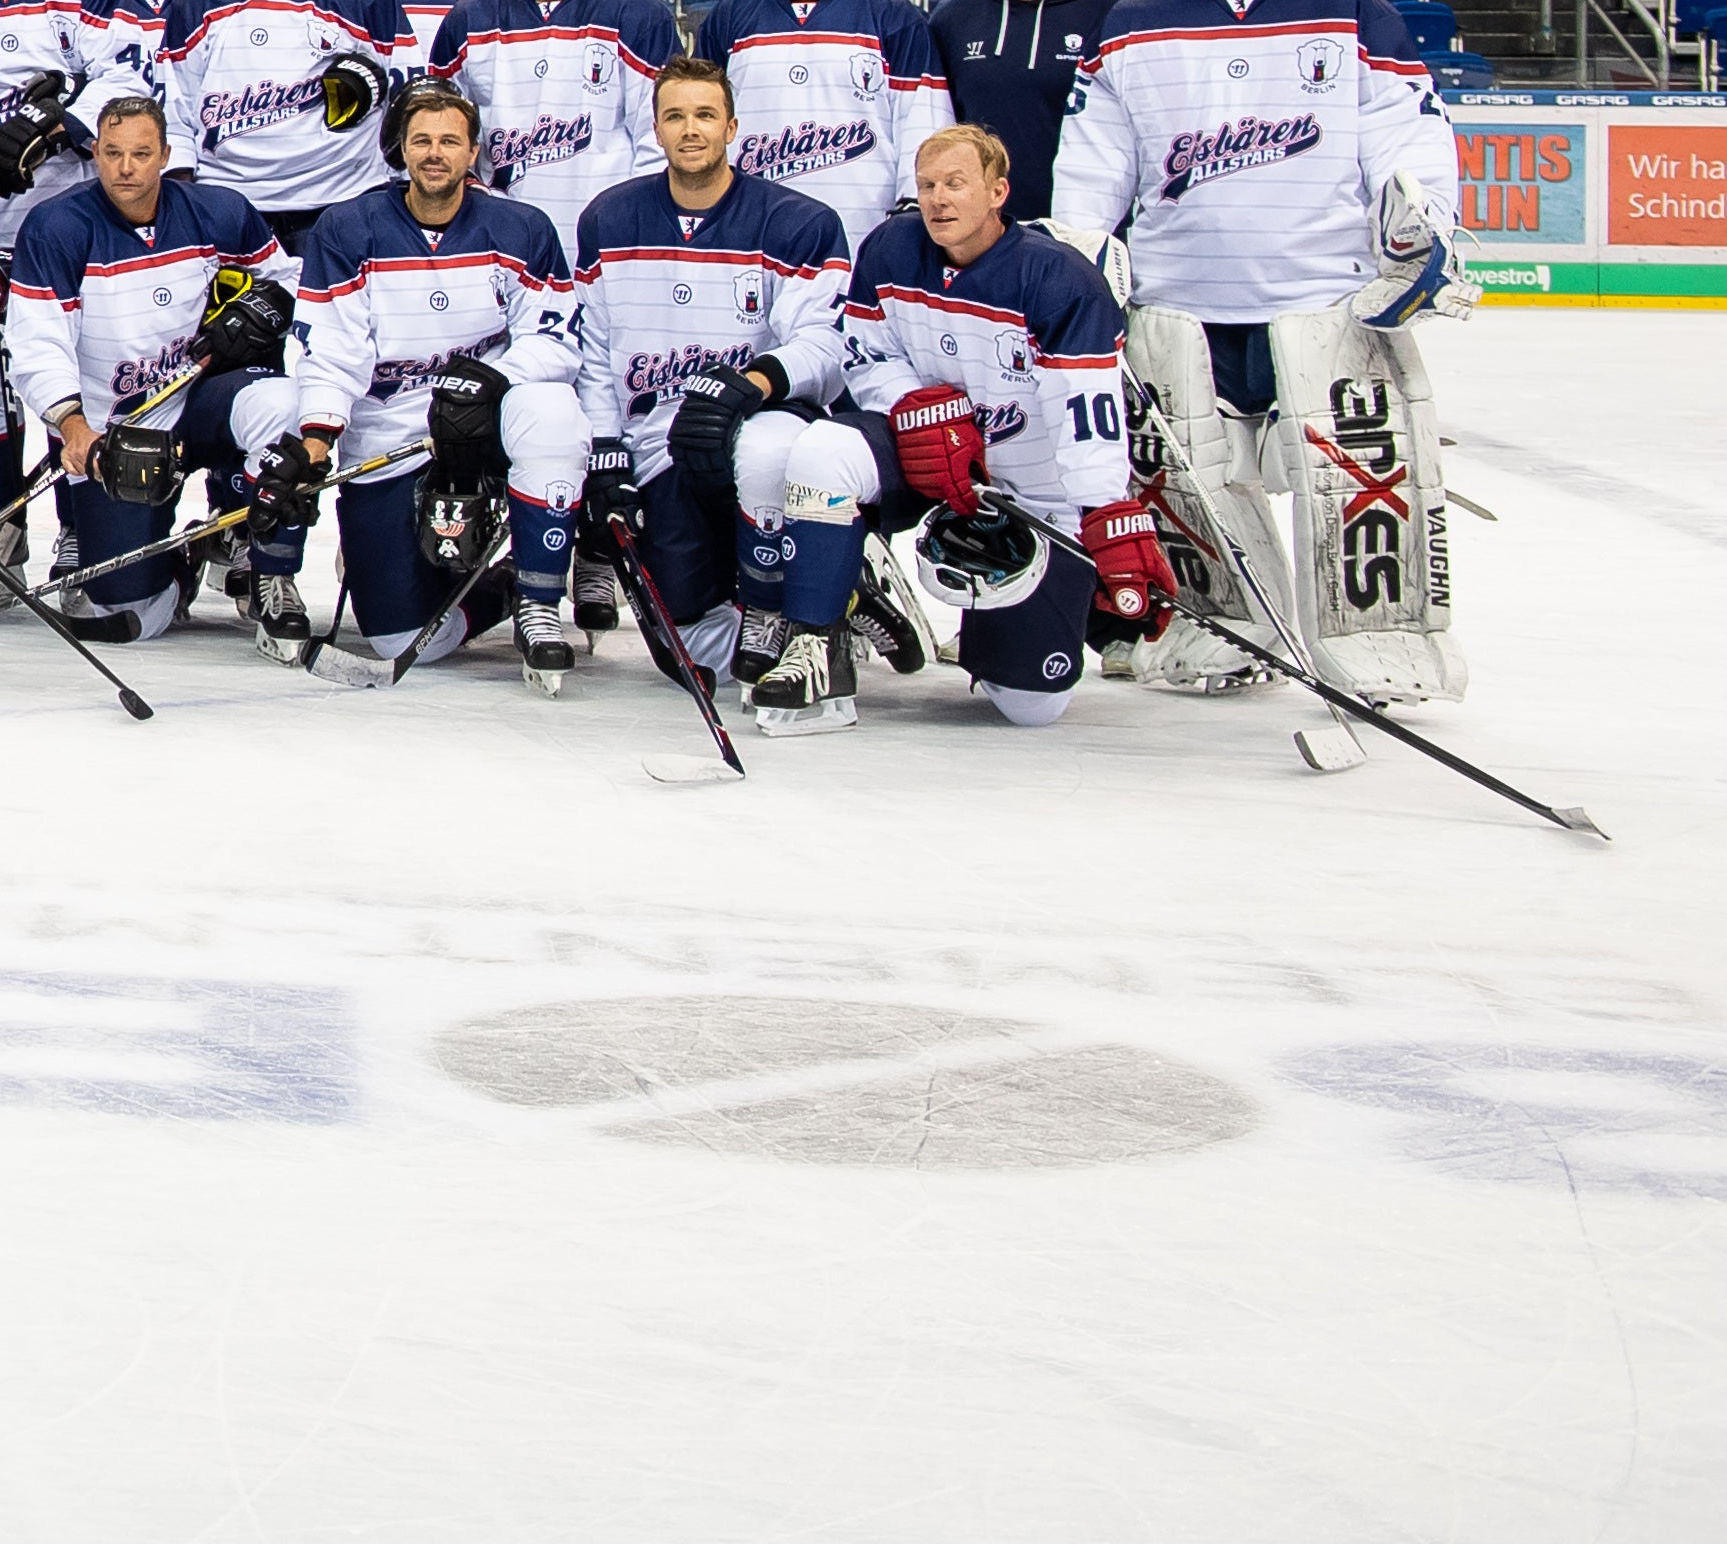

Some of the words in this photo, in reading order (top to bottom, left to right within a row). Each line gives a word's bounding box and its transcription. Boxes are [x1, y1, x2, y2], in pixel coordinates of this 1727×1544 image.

[201, 77, 324, 125] Eisbären
[1460, 93, 1534, 105] GASAG
[1556, 94, 1630, 106] GASAG
[1652, 95, 1726, 107] GASAG
[215, 105, 302, 144] ALLSTARS
[735, 119, 874, 176] Eisbären
[1164, 111, 1320, 178] Eisbären
[761, 149, 847, 183] ALLSTARS
[1188, 145, 1287, 186] ALLSTARS
[1627, 154, 1683, 179] Wir
[1464, 268, 1543, 288] ovestro
[686, 373, 726, 399] RIOR
[896, 395, 975, 433] WARRIO
[1065, 391, 1123, 443] 10
[586, 450, 629, 472] RIOR
[1426, 505, 1452, 609] VAUGHN
